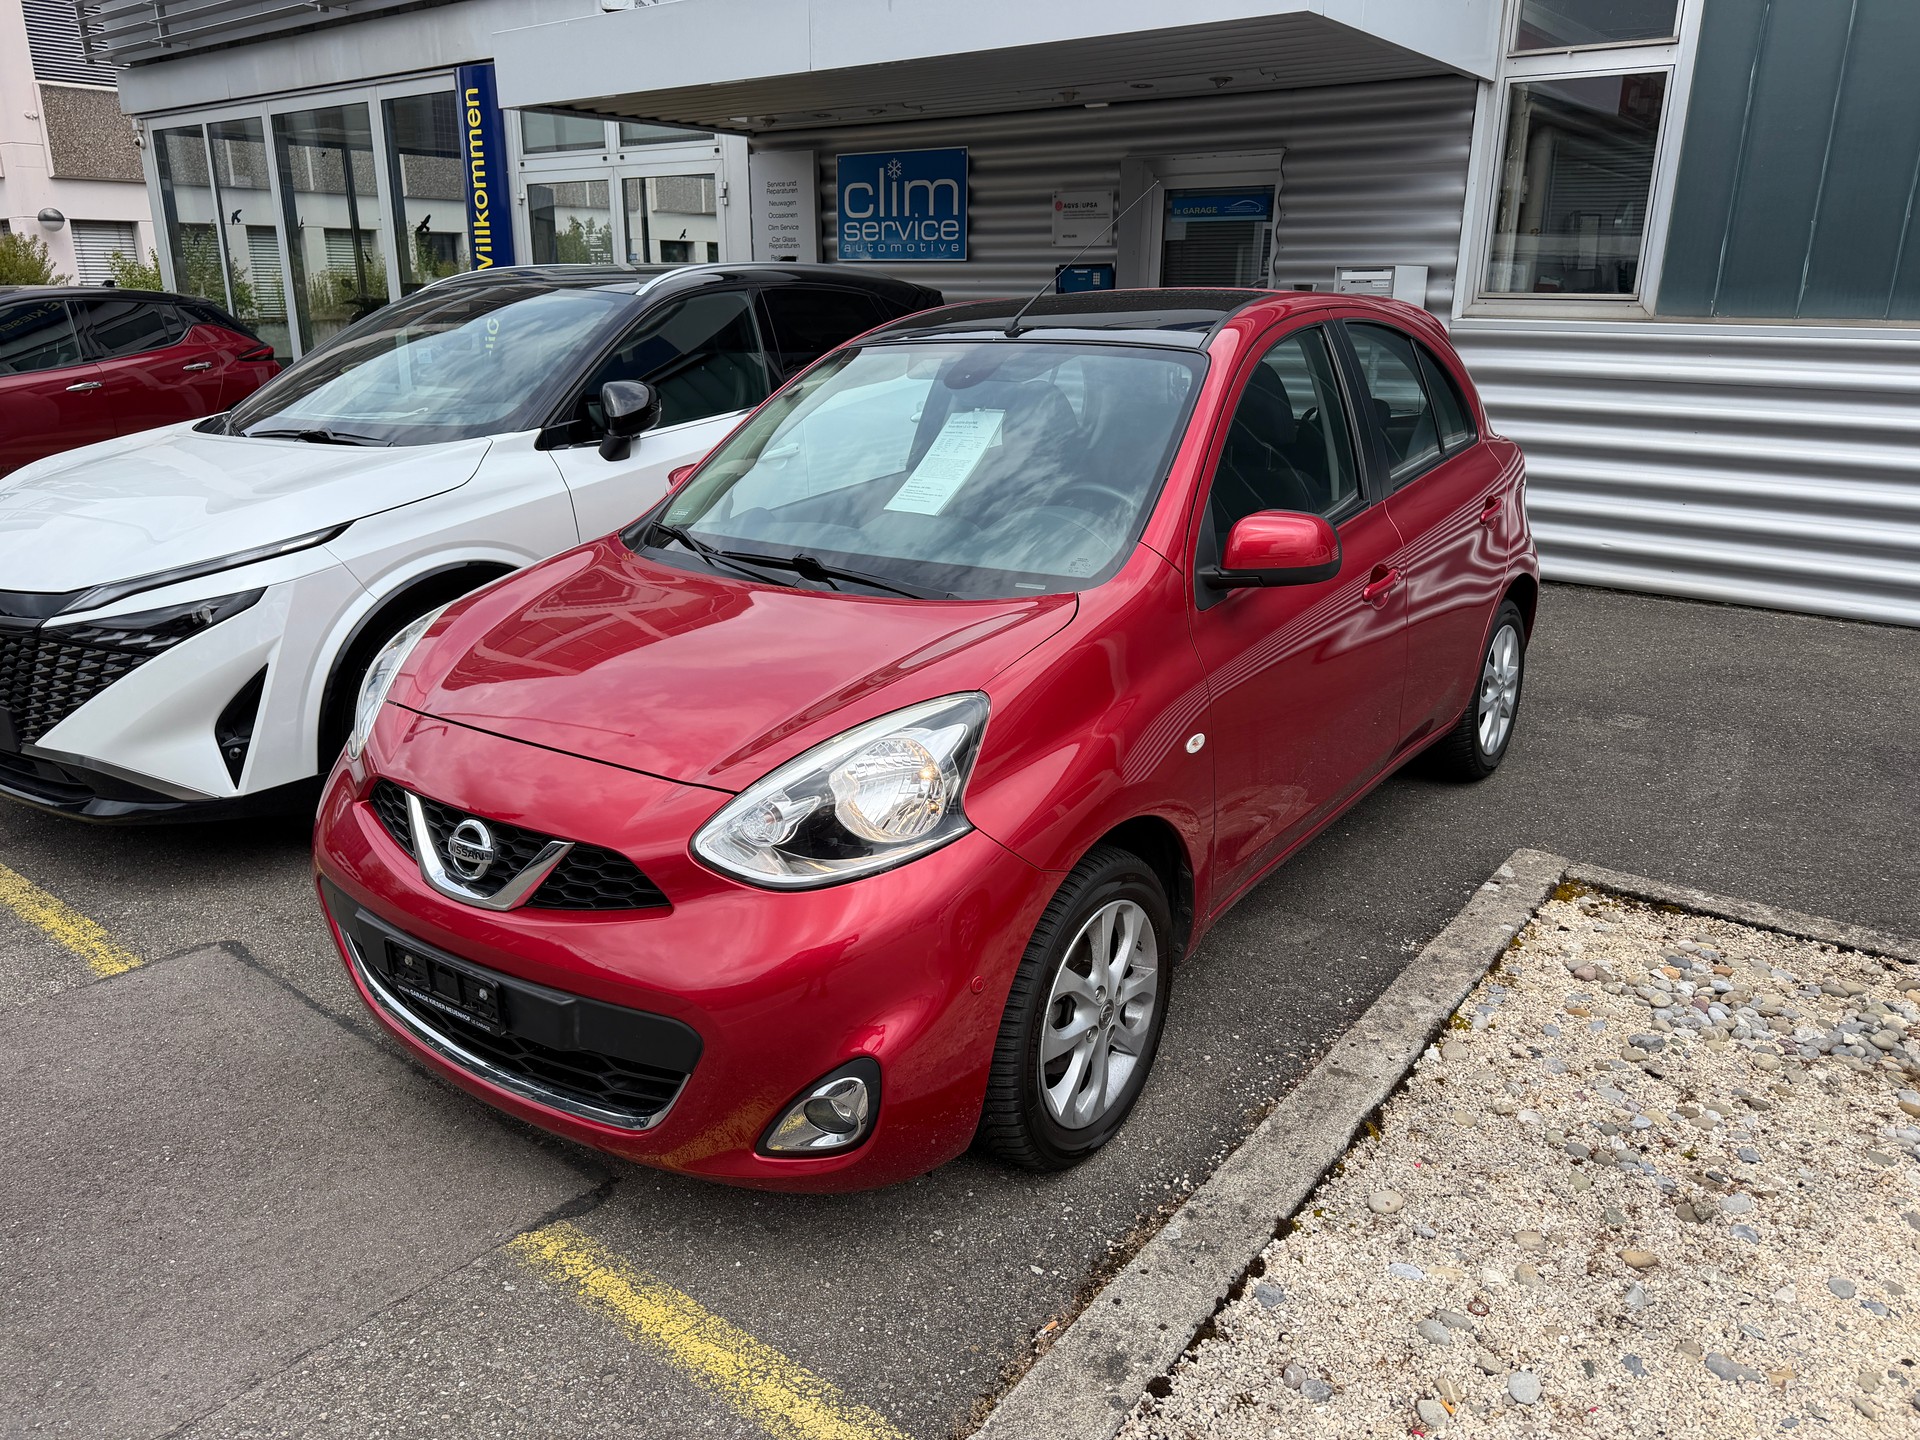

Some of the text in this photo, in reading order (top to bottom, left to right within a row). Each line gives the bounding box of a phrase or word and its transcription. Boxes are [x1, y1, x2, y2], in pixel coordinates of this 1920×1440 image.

[766, 187, 799, 195] Reparaturen
[844, 167, 959, 218] clim
[1182, 206, 1218, 215] GARAGE
[780, 223, 800, 231] Service
[844, 213, 959, 241] service
[768, 242, 800, 250] Reparaturen
[844, 241, 960, 252] automotive
[451, 842, 485, 861] NISSAN
[410, 989, 429, 1003] GARAGE
[428, 998, 446, 1010] KIESER
[445, 1006, 471, 1022] NEUENHOF
[475, 1020, 491, 1031] GARAGE
